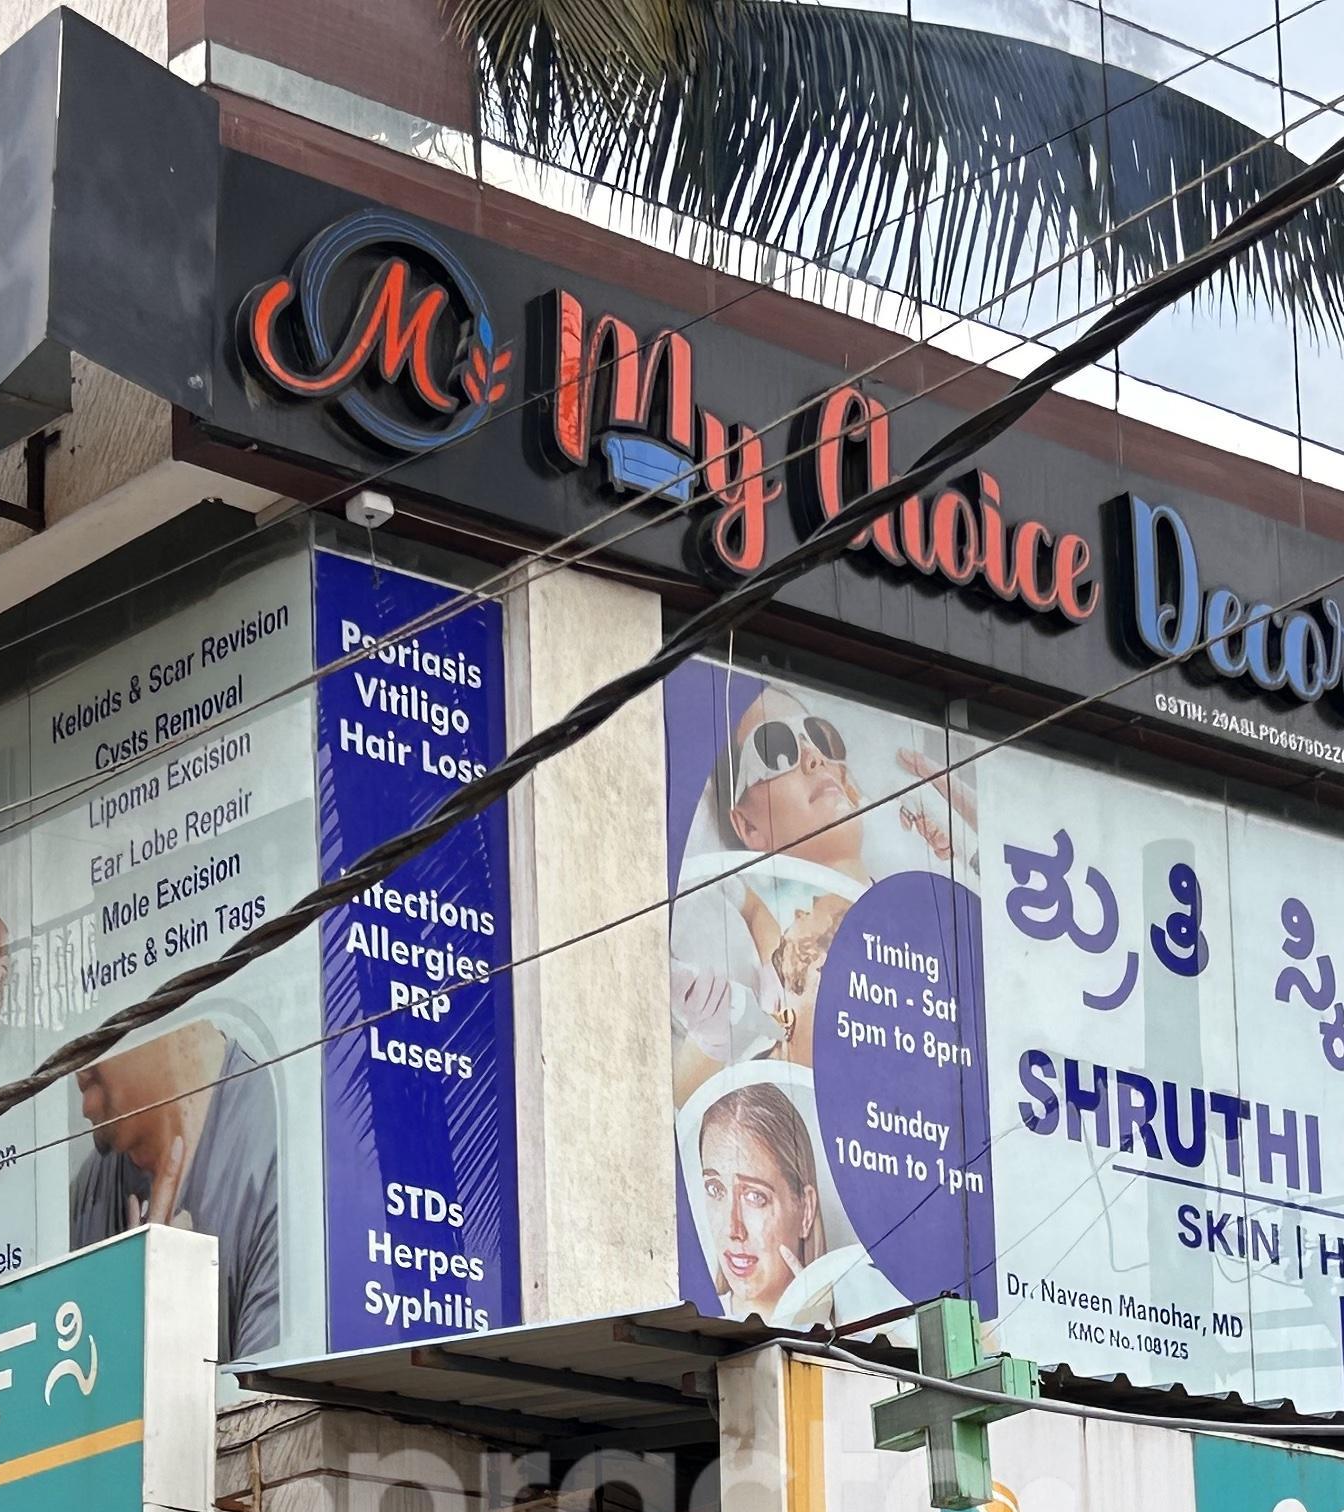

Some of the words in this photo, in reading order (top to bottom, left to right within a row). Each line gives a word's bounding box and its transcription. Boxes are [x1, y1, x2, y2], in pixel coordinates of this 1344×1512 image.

[556, 288, 781, 573] My
[52, 690, 122, 744] Keloids
[129, 675, 142, 704] &
[149, 655, 195, 694] Scar
[201, 604, 289, 669] Revision
[354, 672, 470, 737] Vitiligo
[156, 675, 244, 745] Removal
[89, 773, 160, 830] Lipoma
[167, 729, 252, 792] Excision
[340, 718, 411, 766] Hair
[422, 741, 488, 784] Loss
[90, 851, 122, 887] Ear
[130, 826, 178, 869] Lobe
[186, 789, 253, 844] Repair
[102, 892, 151, 935] Mole
[156, 851, 241, 909] Excision
[80, 948, 138, 995] Warts
[144, 937, 157, 967] &
[165, 917, 210, 959] Skin
[215, 894, 266, 939] Tags
[346, 921, 491, 985] Allergies
[862, 932, 939, 983] Timing
[390, 981, 451, 1023] PRP
[849, 971, 899, 1008] Mon
[923, 989, 957, 1022] Sat
[370, 1027, 473, 1081] Lasers
[837, 1012, 886, 1048] 5pm
[894, 1026, 915, 1053] to
[924, 1031, 971, 1068] 8pm
[867, 1101, 950, 1150] Sunday
[1017, 1048, 1323, 1196] SHRUTHI
[836, 1137, 899, 1176] 10am
[906, 1152, 927, 1181] to
[936, 1158, 983, 1195] 1pm
[386, 1183, 465, 1228] STDs
[1177, 1203, 1280, 1266] SKIN
[369, 1231, 485, 1283] Herpes
[365, 1281, 490, 1333] Syphilis
[1007, 1272, 1035, 1299] Dr.
[1041, 1279, 1112, 1315] Naveen
[1119, 1294, 1207, 1336] Manohar,
[1213, 1312, 1244, 1338] MD
[1068, 1320, 1105, 1344] KMC
